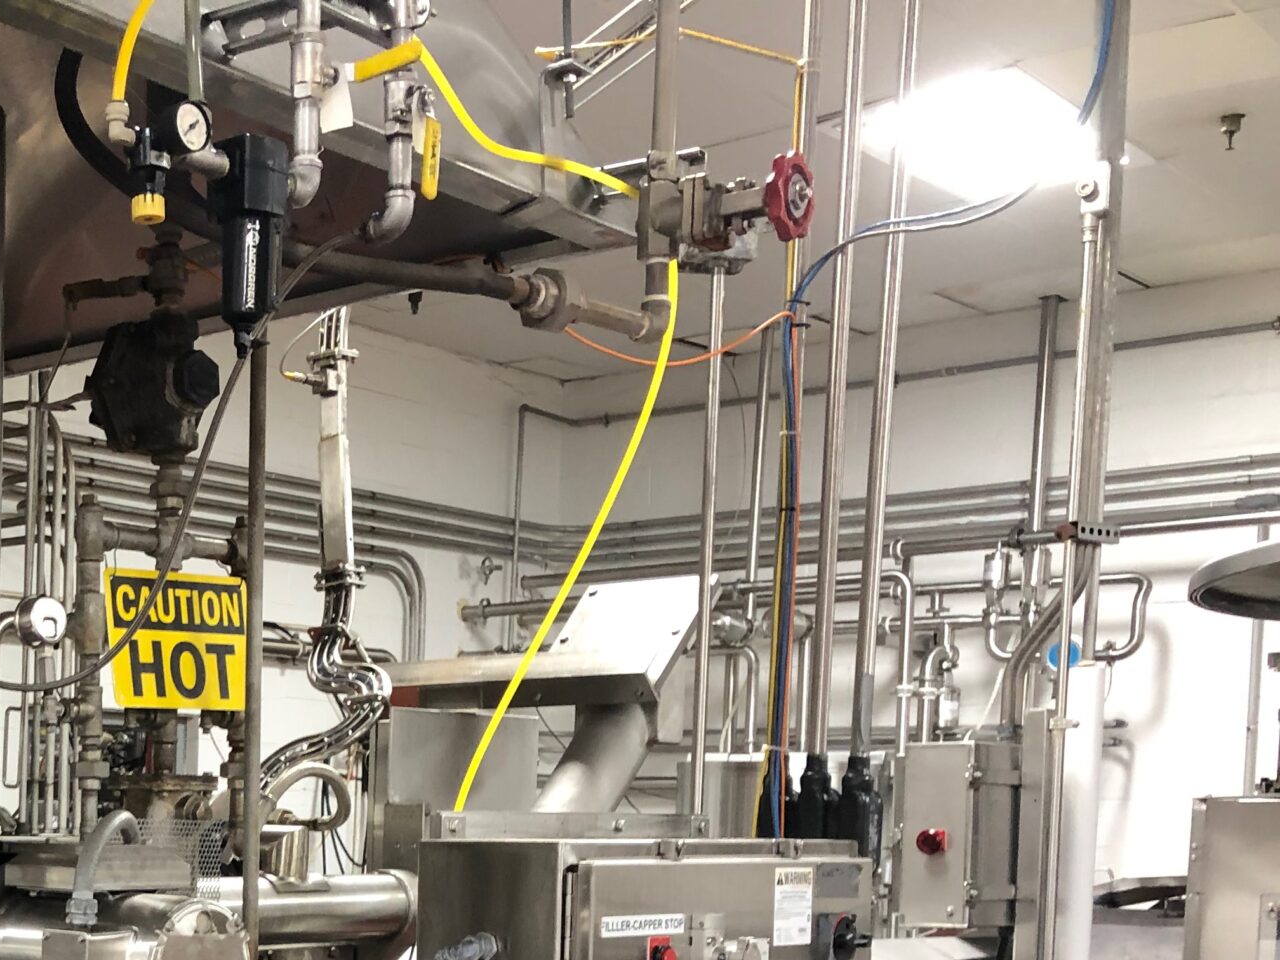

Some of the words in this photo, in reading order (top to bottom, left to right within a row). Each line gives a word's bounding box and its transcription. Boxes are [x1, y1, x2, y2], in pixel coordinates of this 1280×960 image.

[246, 246, 257, 309] NORGREN
[116, 584, 241, 627] CAUTION
[129, 638, 236, 700] HOT
[664, 918, 684, 930] STOP
